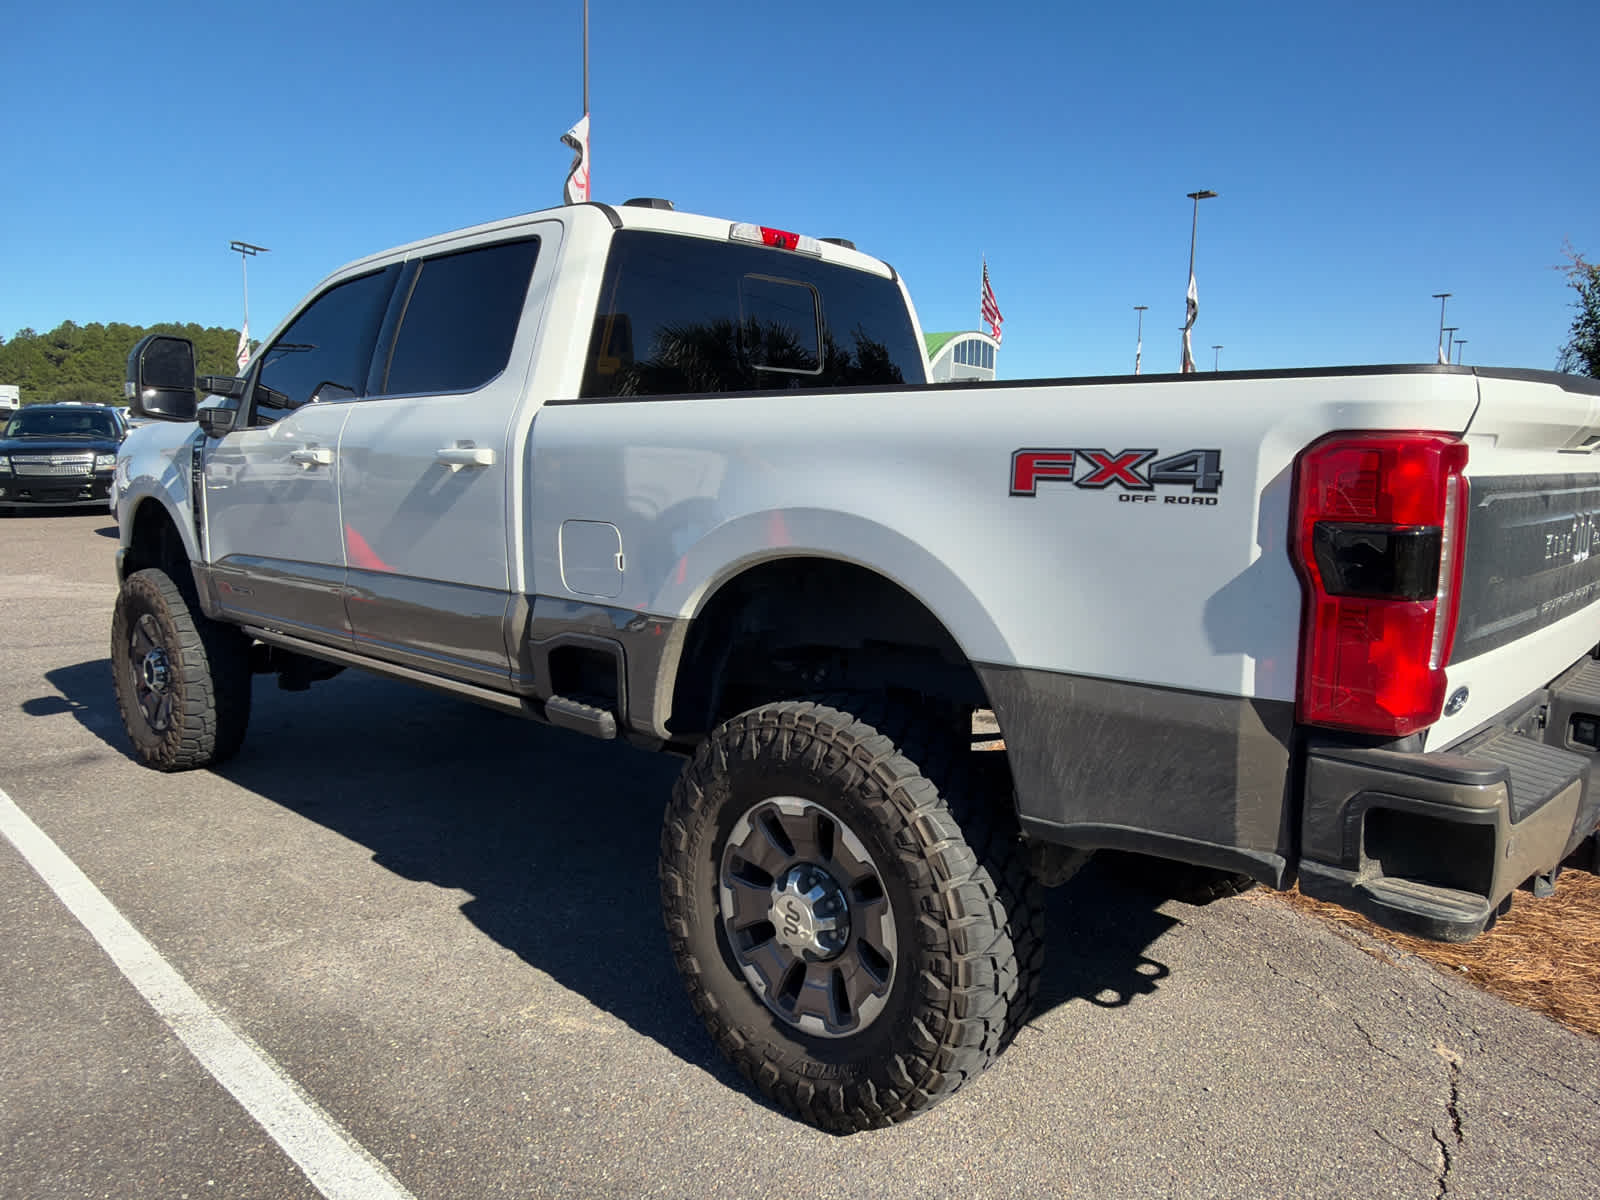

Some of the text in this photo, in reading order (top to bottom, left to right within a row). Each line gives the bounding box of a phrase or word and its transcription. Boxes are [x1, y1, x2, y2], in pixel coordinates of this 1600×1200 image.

[1008, 447, 1223, 498] FX4
[1118, 494, 1219, 506] OFF ROAD
